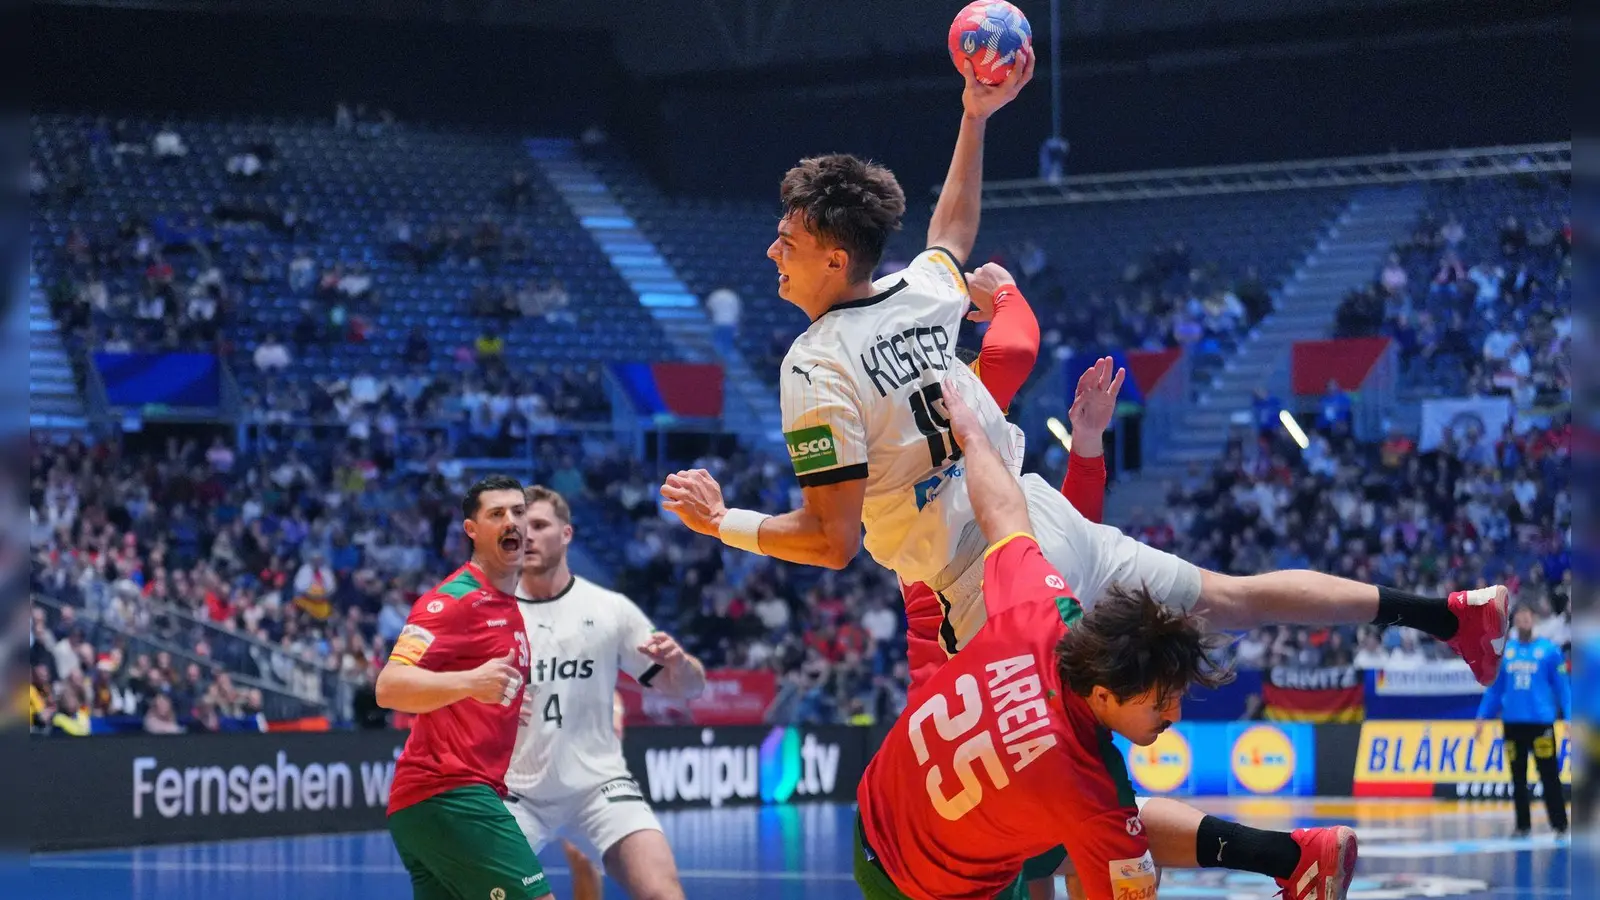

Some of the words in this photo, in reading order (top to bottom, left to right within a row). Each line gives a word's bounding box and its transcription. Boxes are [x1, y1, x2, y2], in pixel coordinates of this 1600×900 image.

[860, 325, 951, 397] KÖSTER
[543, 693, 562, 728] 4
[908, 674, 1010, 821] 25
[985, 654, 1057, 772] AREIA
[133, 751, 353, 818] Fernsehen
[645, 729, 758, 807] waipu
